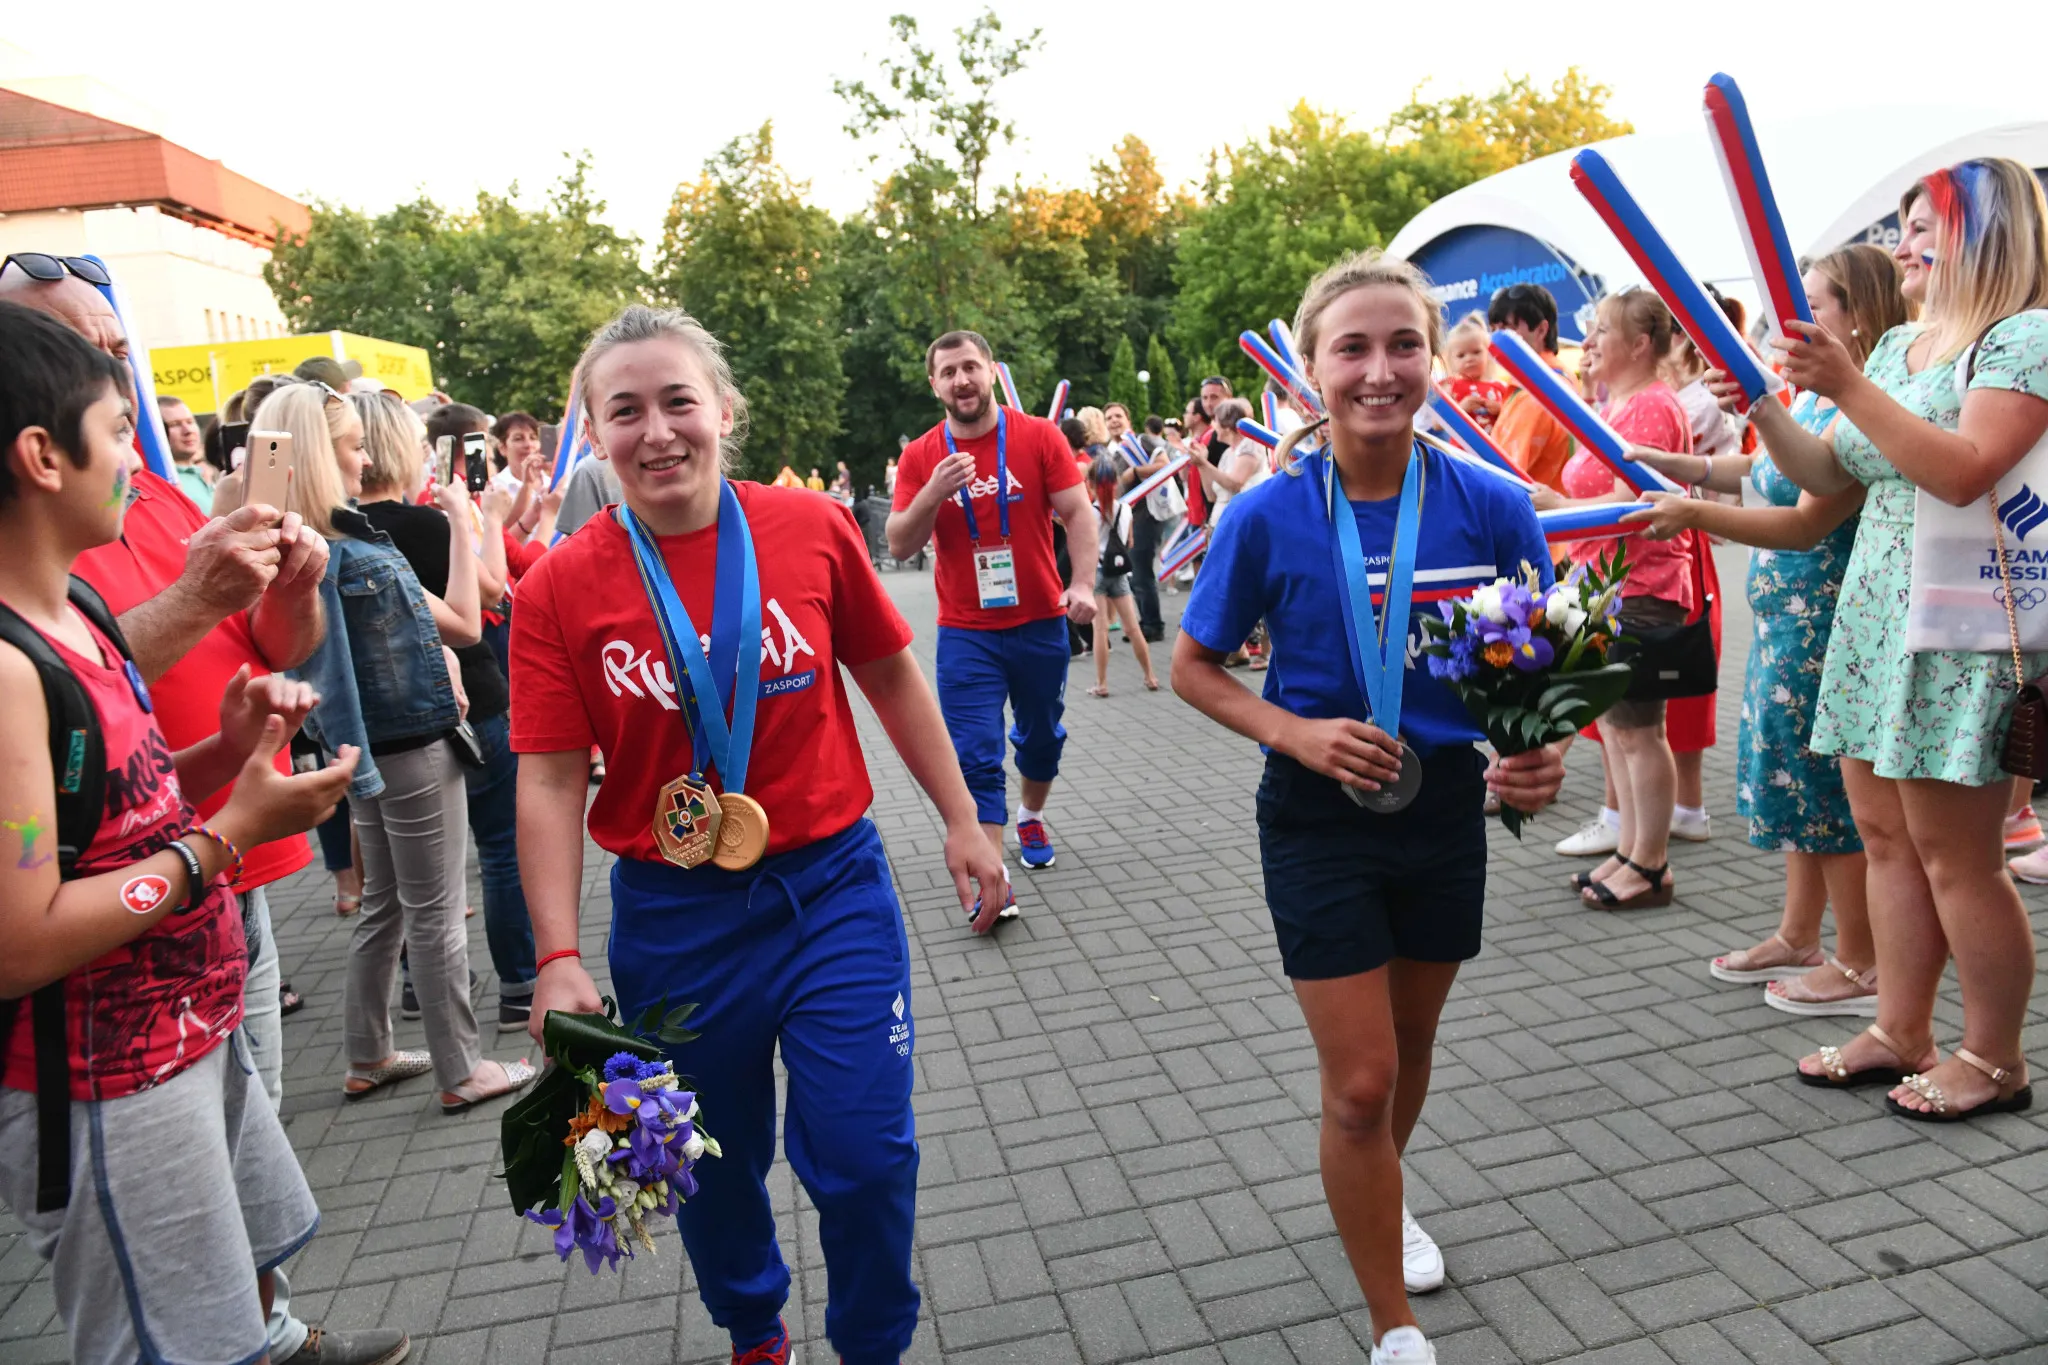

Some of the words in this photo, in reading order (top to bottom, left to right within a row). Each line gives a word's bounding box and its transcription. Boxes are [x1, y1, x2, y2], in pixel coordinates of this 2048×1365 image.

[1479, 261, 1567, 295] Accelerator
[1363, 555, 1390, 566] ZASP
[1987, 548, 2048, 563] TEAM
[1979, 565, 2048, 580] RUSSI
[765, 674, 811, 694] ZASPORT
[891, 1022, 908, 1034] TEAM
